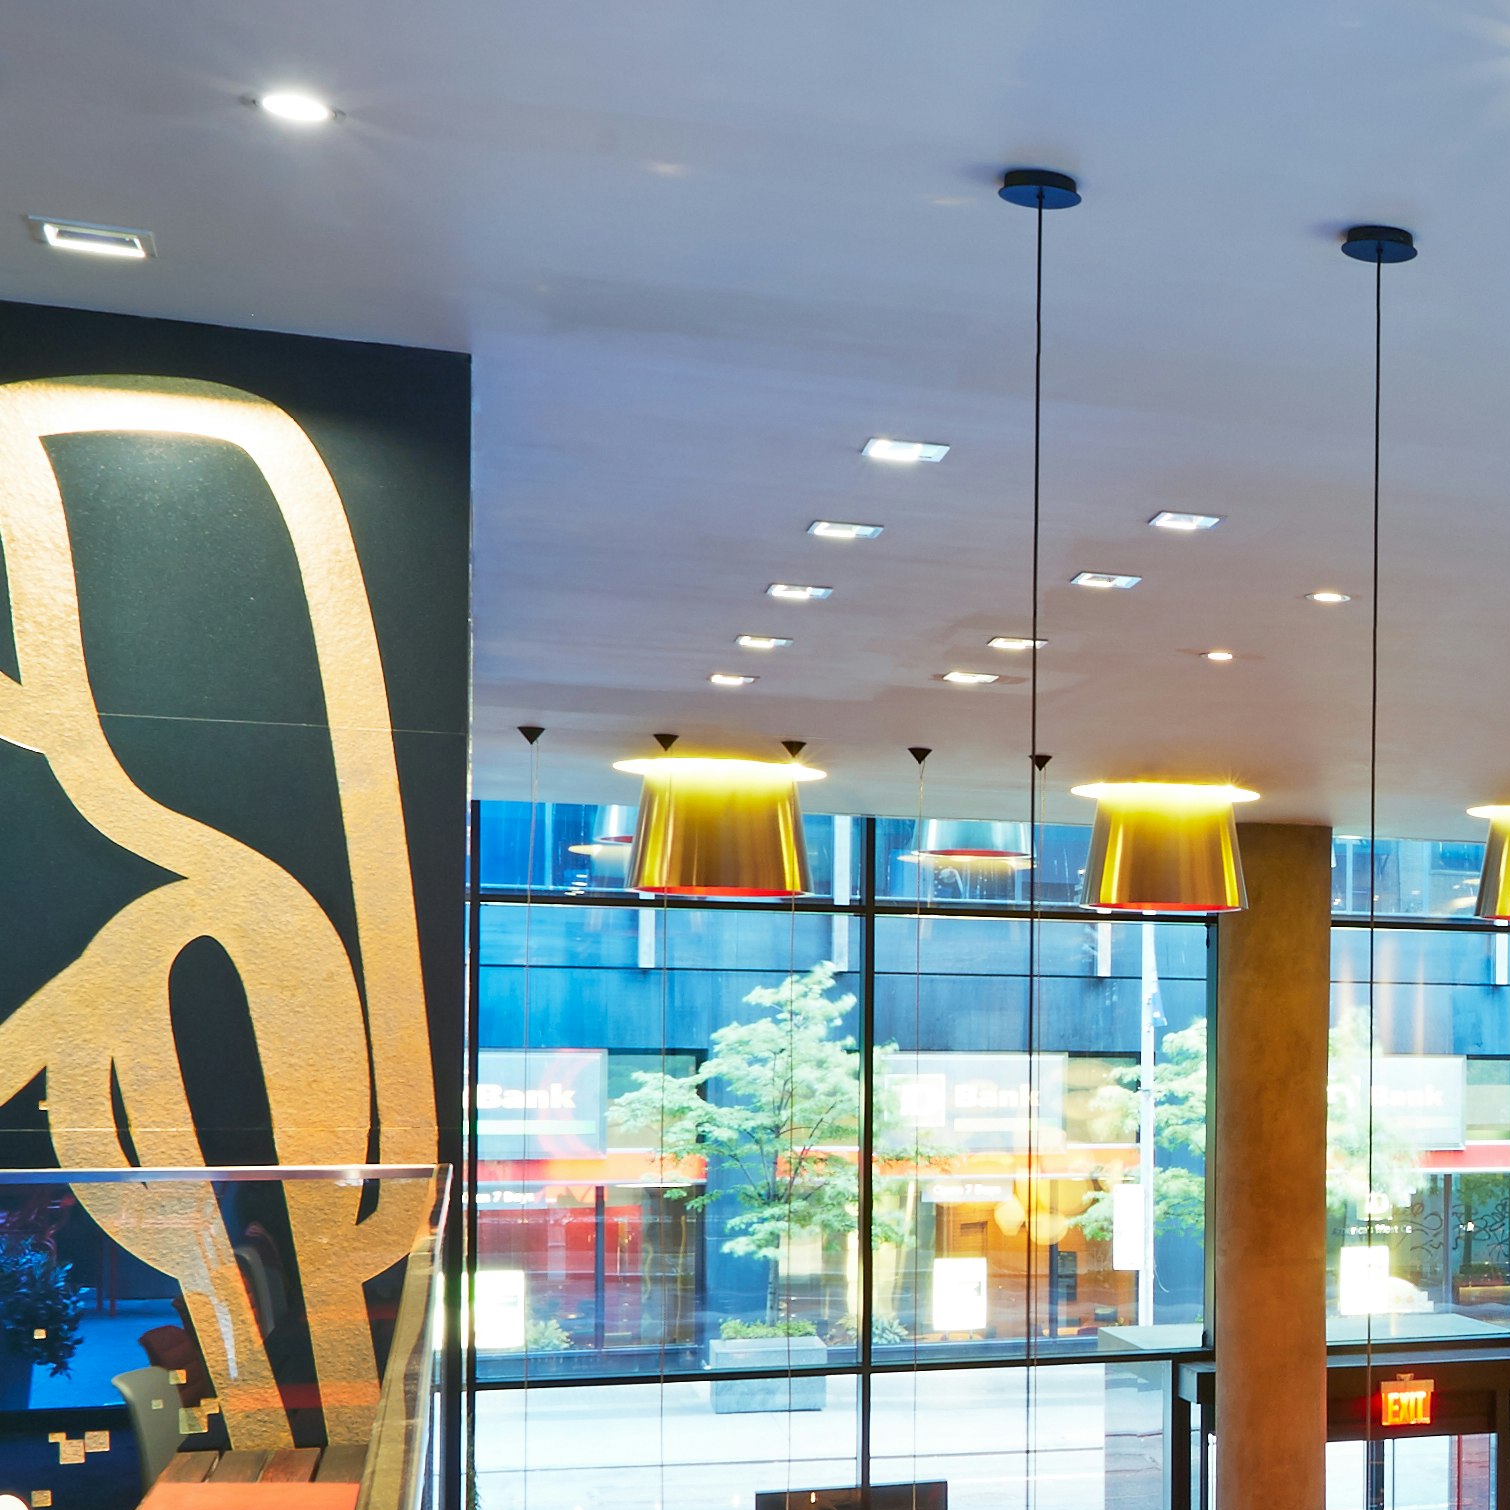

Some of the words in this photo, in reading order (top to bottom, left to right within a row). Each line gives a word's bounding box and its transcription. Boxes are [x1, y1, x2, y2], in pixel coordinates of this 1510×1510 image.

[477, 1083, 576, 1109] Bank
[954, 1083, 1040, 1108] Bank
[1388, 1391, 1427, 1423] EXIT
